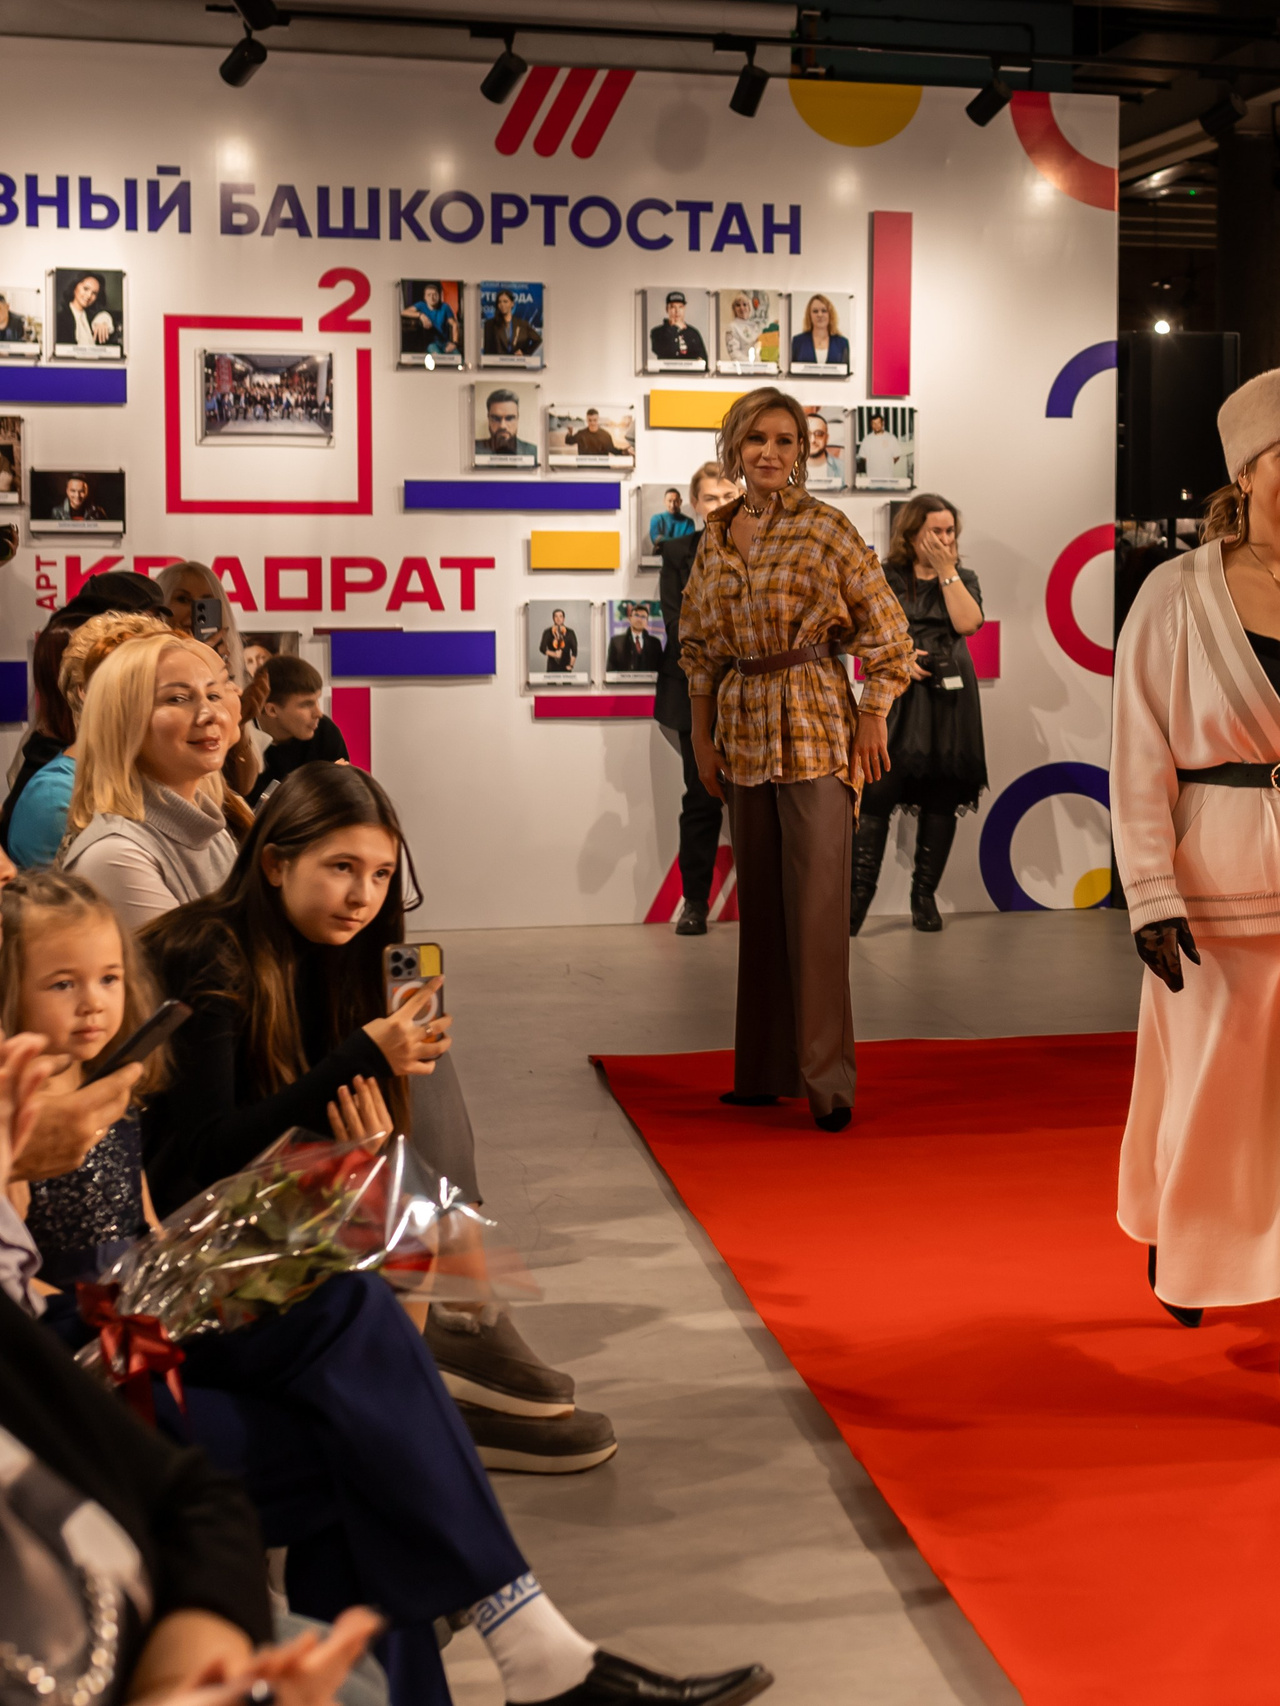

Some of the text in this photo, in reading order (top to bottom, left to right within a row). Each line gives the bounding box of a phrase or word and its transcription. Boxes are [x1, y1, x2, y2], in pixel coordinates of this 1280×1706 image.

[219, 181, 801, 255] БАШКОРТОСТАН
[318, 266, 371, 333] 2
[35, 554, 57, 612] АРТ
